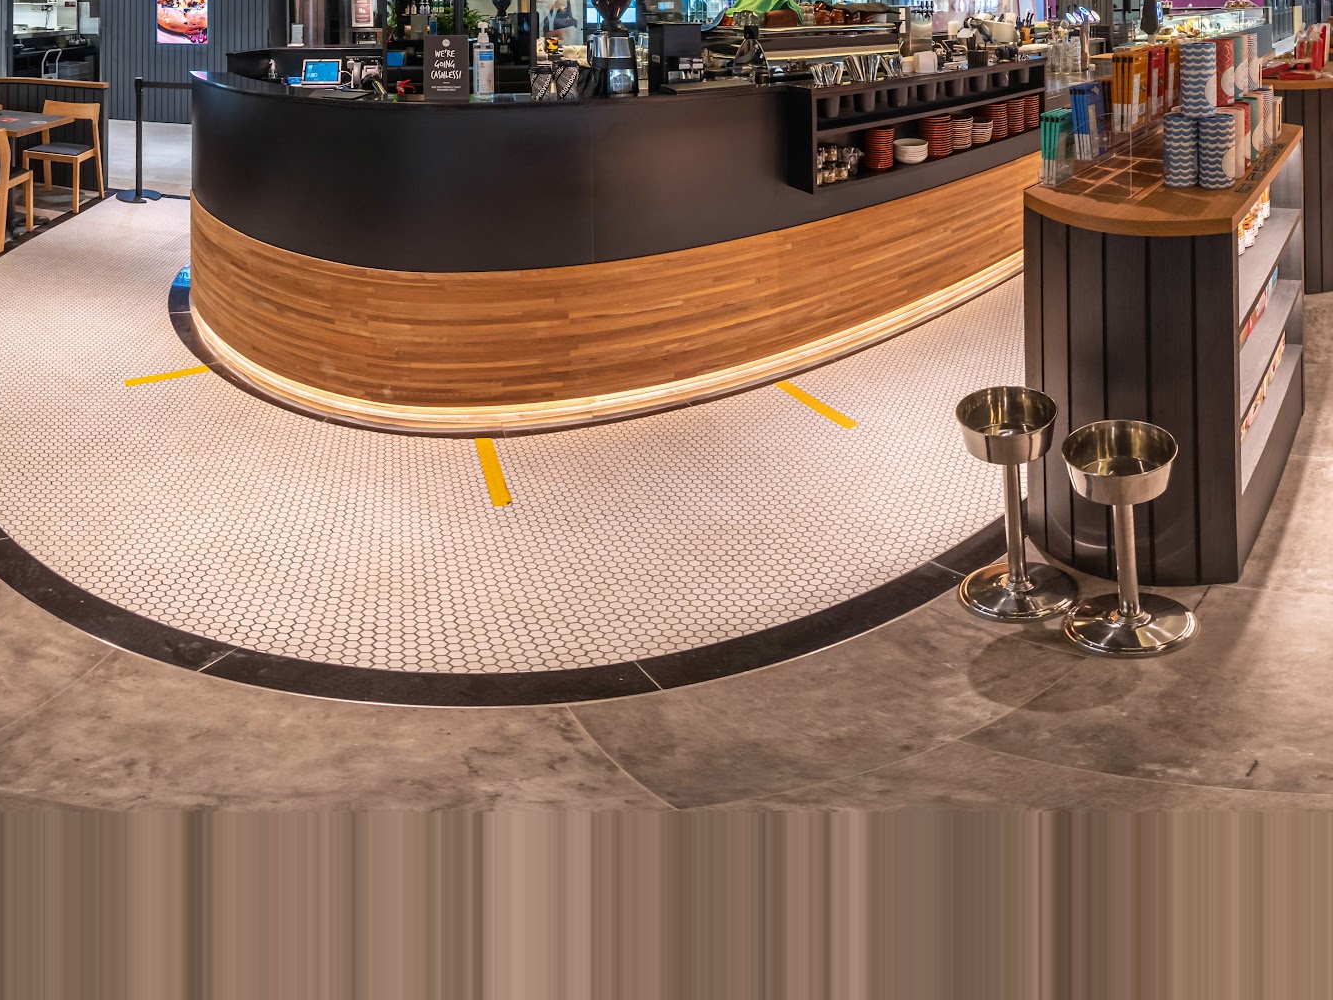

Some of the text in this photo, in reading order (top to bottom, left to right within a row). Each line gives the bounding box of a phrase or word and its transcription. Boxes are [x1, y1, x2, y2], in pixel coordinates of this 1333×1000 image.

[434, 49, 456, 58] WE'RE
[434, 60, 455, 68] GOING
[430, 70, 462, 80] CASHLESS!
